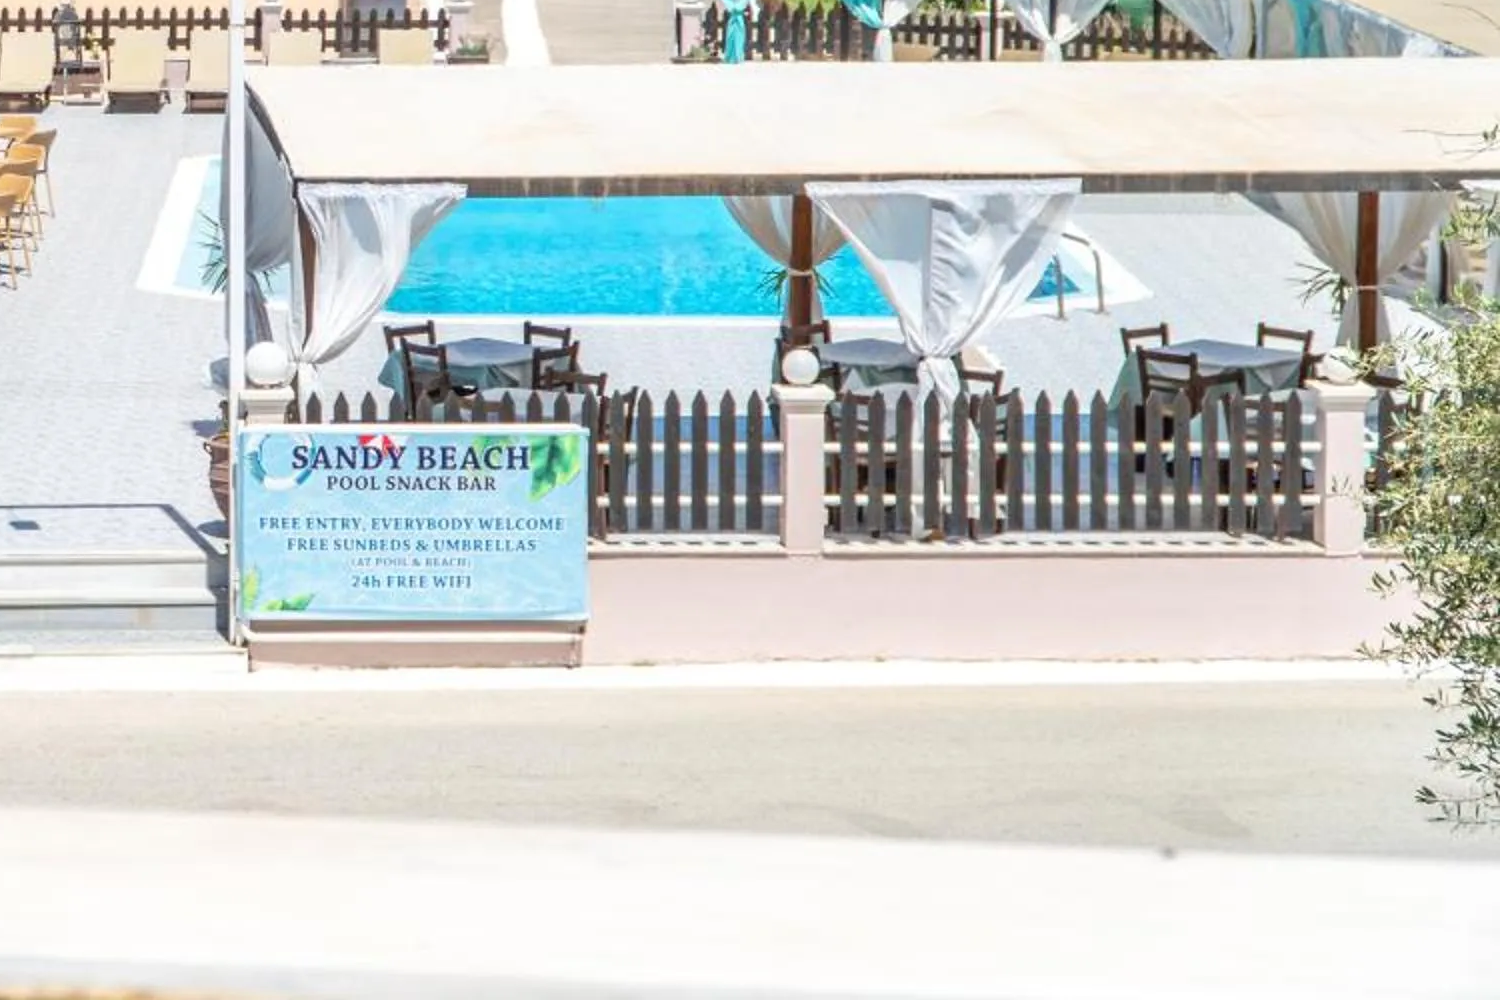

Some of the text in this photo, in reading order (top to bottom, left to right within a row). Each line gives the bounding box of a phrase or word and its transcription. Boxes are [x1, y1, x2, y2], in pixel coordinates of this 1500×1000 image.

[292, 446, 530, 471] SANDY BEACH
[326, 475, 497, 491] POOL SNACK BAR
[259, 517, 565, 532] FREE ENTRY, EVERYBODY WELCOME
[287, 538, 537, 552] FREE SUNBEDS & UMBRELLAS
[374, 557, 408, 568] POOL
[351, 575, 472, 589] 24h FREE WIFI
